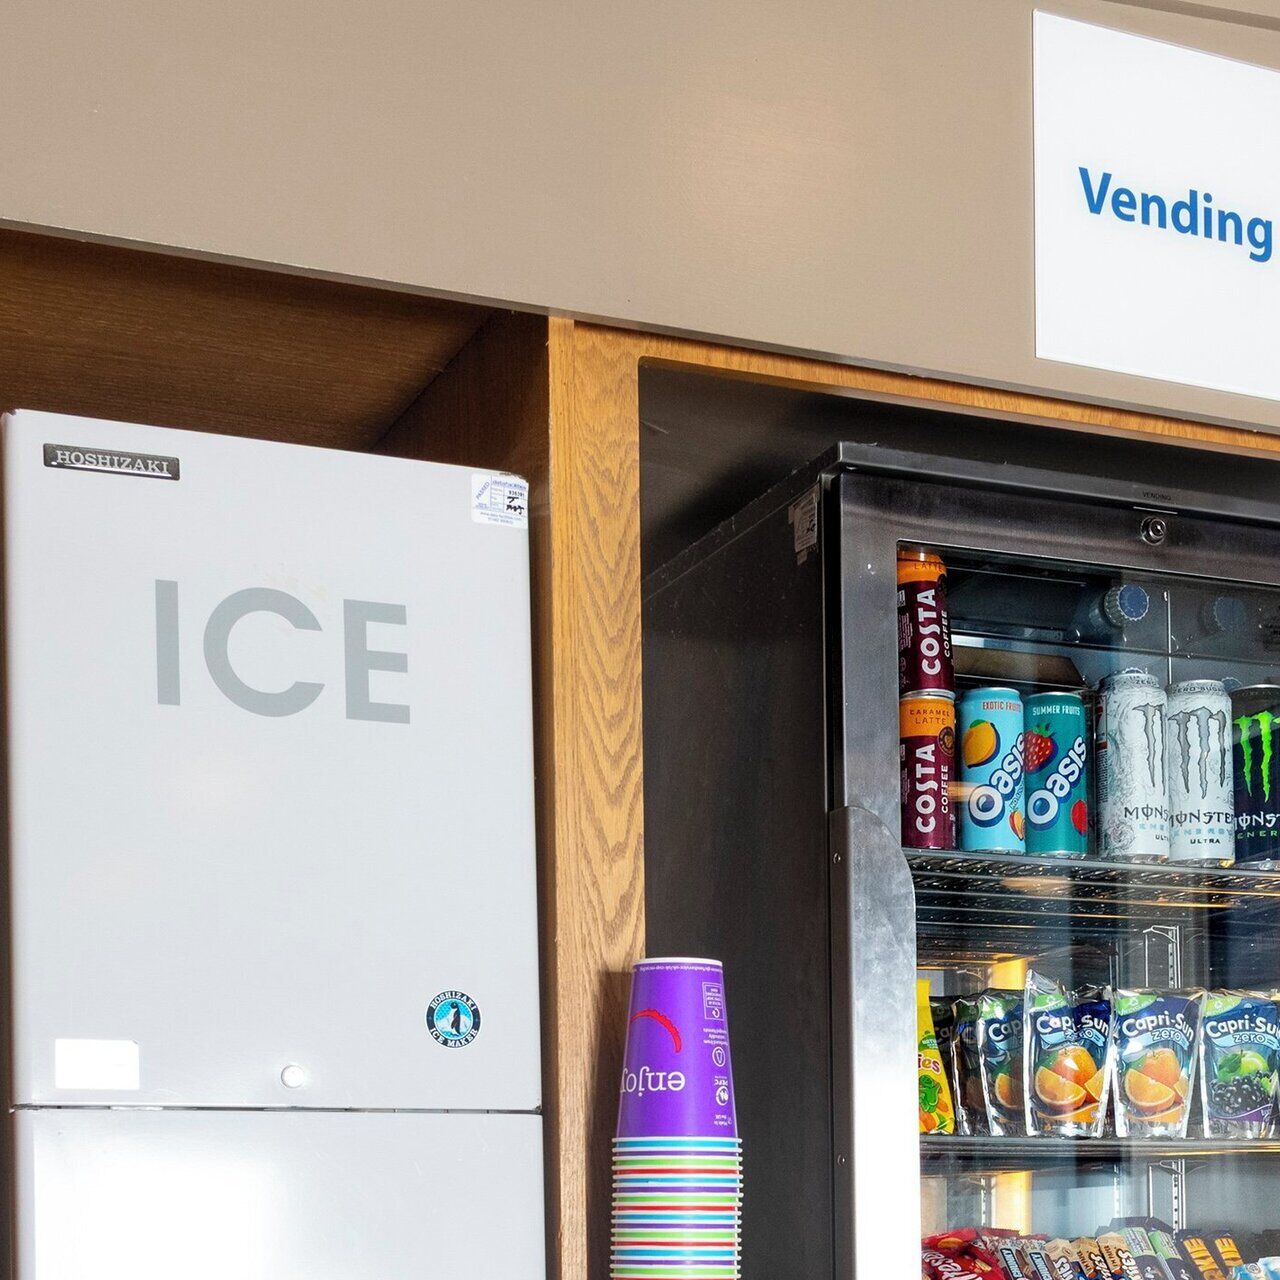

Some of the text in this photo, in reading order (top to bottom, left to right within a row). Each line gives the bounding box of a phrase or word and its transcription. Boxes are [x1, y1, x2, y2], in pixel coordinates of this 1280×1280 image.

[1077, 166, 1273, 263] Vending
[56, 449, 170, 475] HOSHIZAKI
[916, 588, 942, 675] COSTA
[943, 609, 951, 658] COFFEE
[154, 578, 410, 724] ICE
[910, 708, 951, 718] CARAMEL
[982, 701, 1004, 711] EXOTIC
[1032, 705, 1080, 716] SUMMER FRUITS
[915, 716, 948, 726] LATTE
[915, 743, 939, 834] COSTA
[941, 765, 949, 814] COFFEE
[1027, 736, 1087, 825] Oasis
[1190, 837, 1221, 845] ULTRA
[430, 991, 477, 1011] HOSHIZAKI
[430, 1028, 477, 1048] ICE MAKER
[1122, 1010, 1194, 1043] Capri-Sun
[1151, 1030, 1181, 1042] zero
[1234, 1033, 1266, 1044] zero
